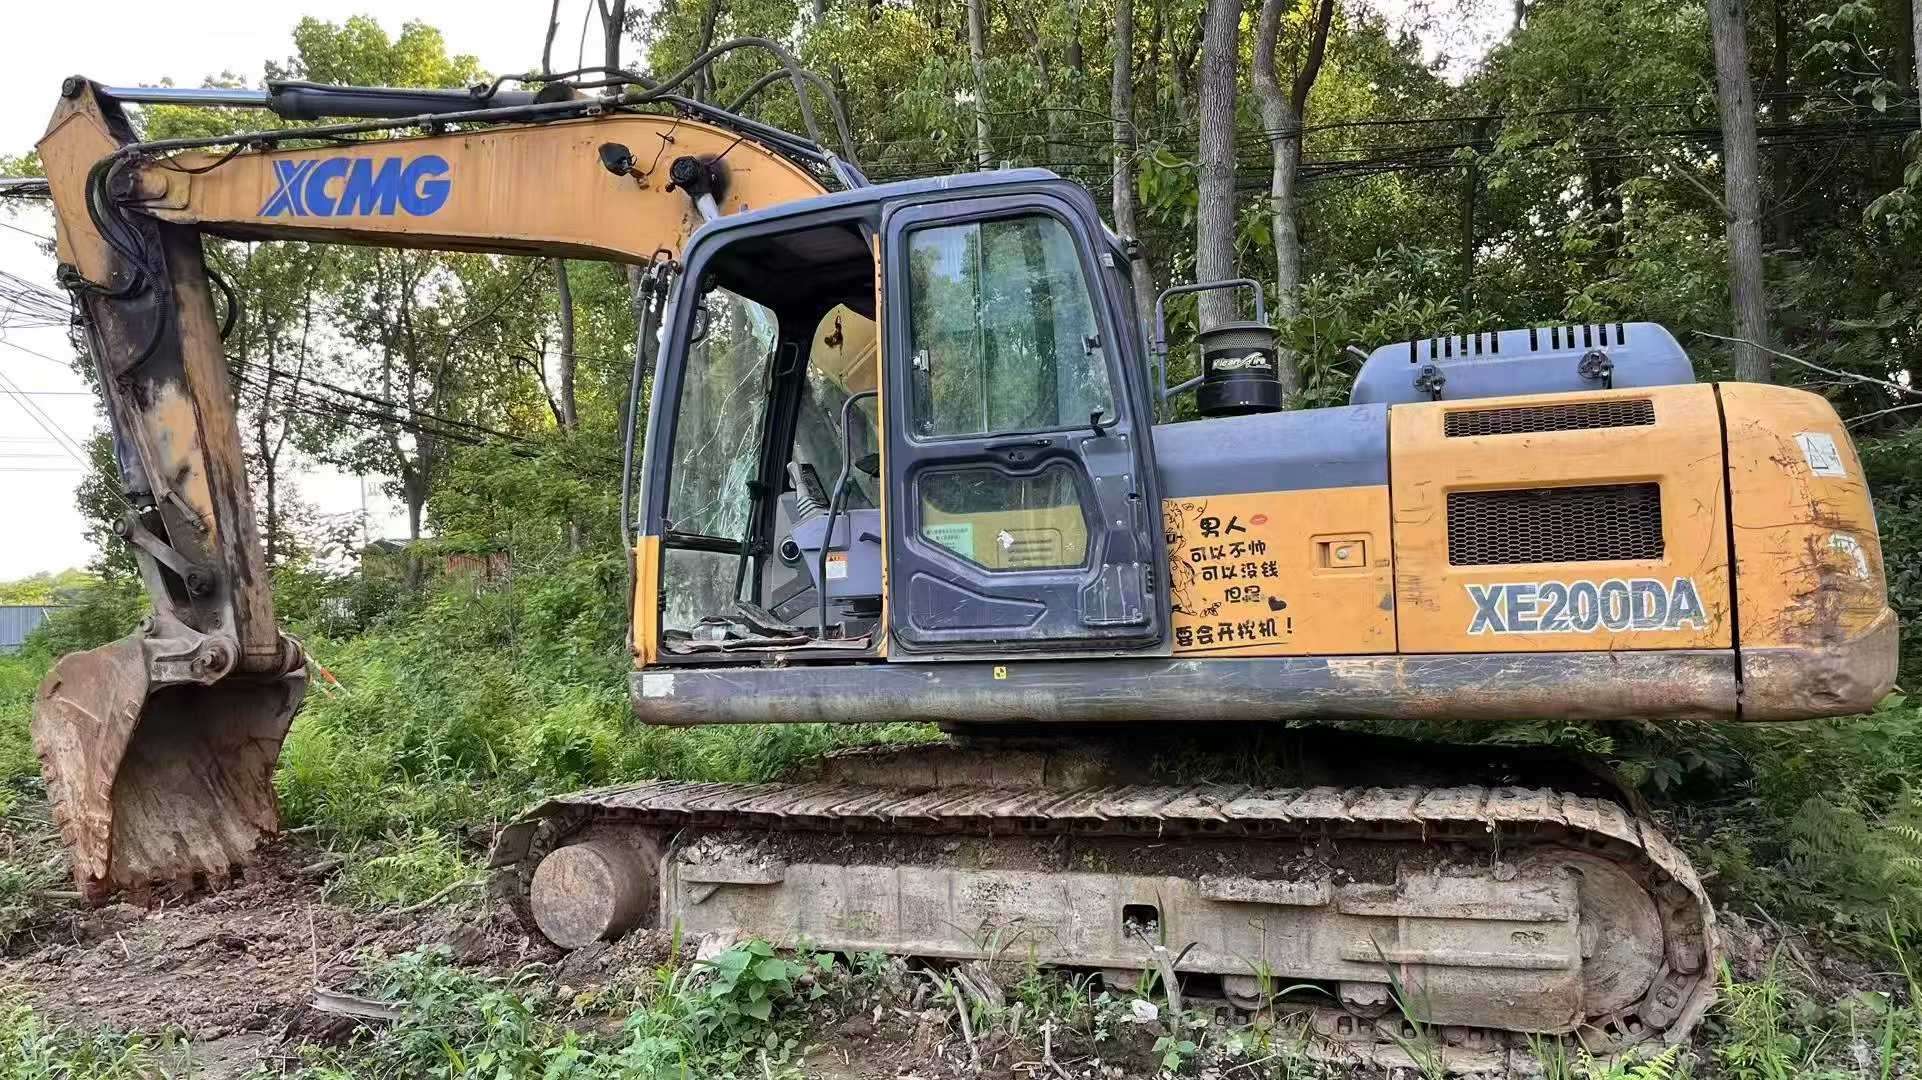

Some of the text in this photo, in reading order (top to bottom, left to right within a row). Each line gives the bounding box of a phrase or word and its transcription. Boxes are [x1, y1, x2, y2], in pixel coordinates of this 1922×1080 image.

[256, 154, 452, 217] XCMG
[1199, 515, 1247, 538] 男人
[1189, 539, 1267, 563] 可以不帅
[1201, 560, 1280, 582] 可以没钱
[1224, 585, 1262, 603] 但是
[1464, 576, 1708, 635] XE200DA
